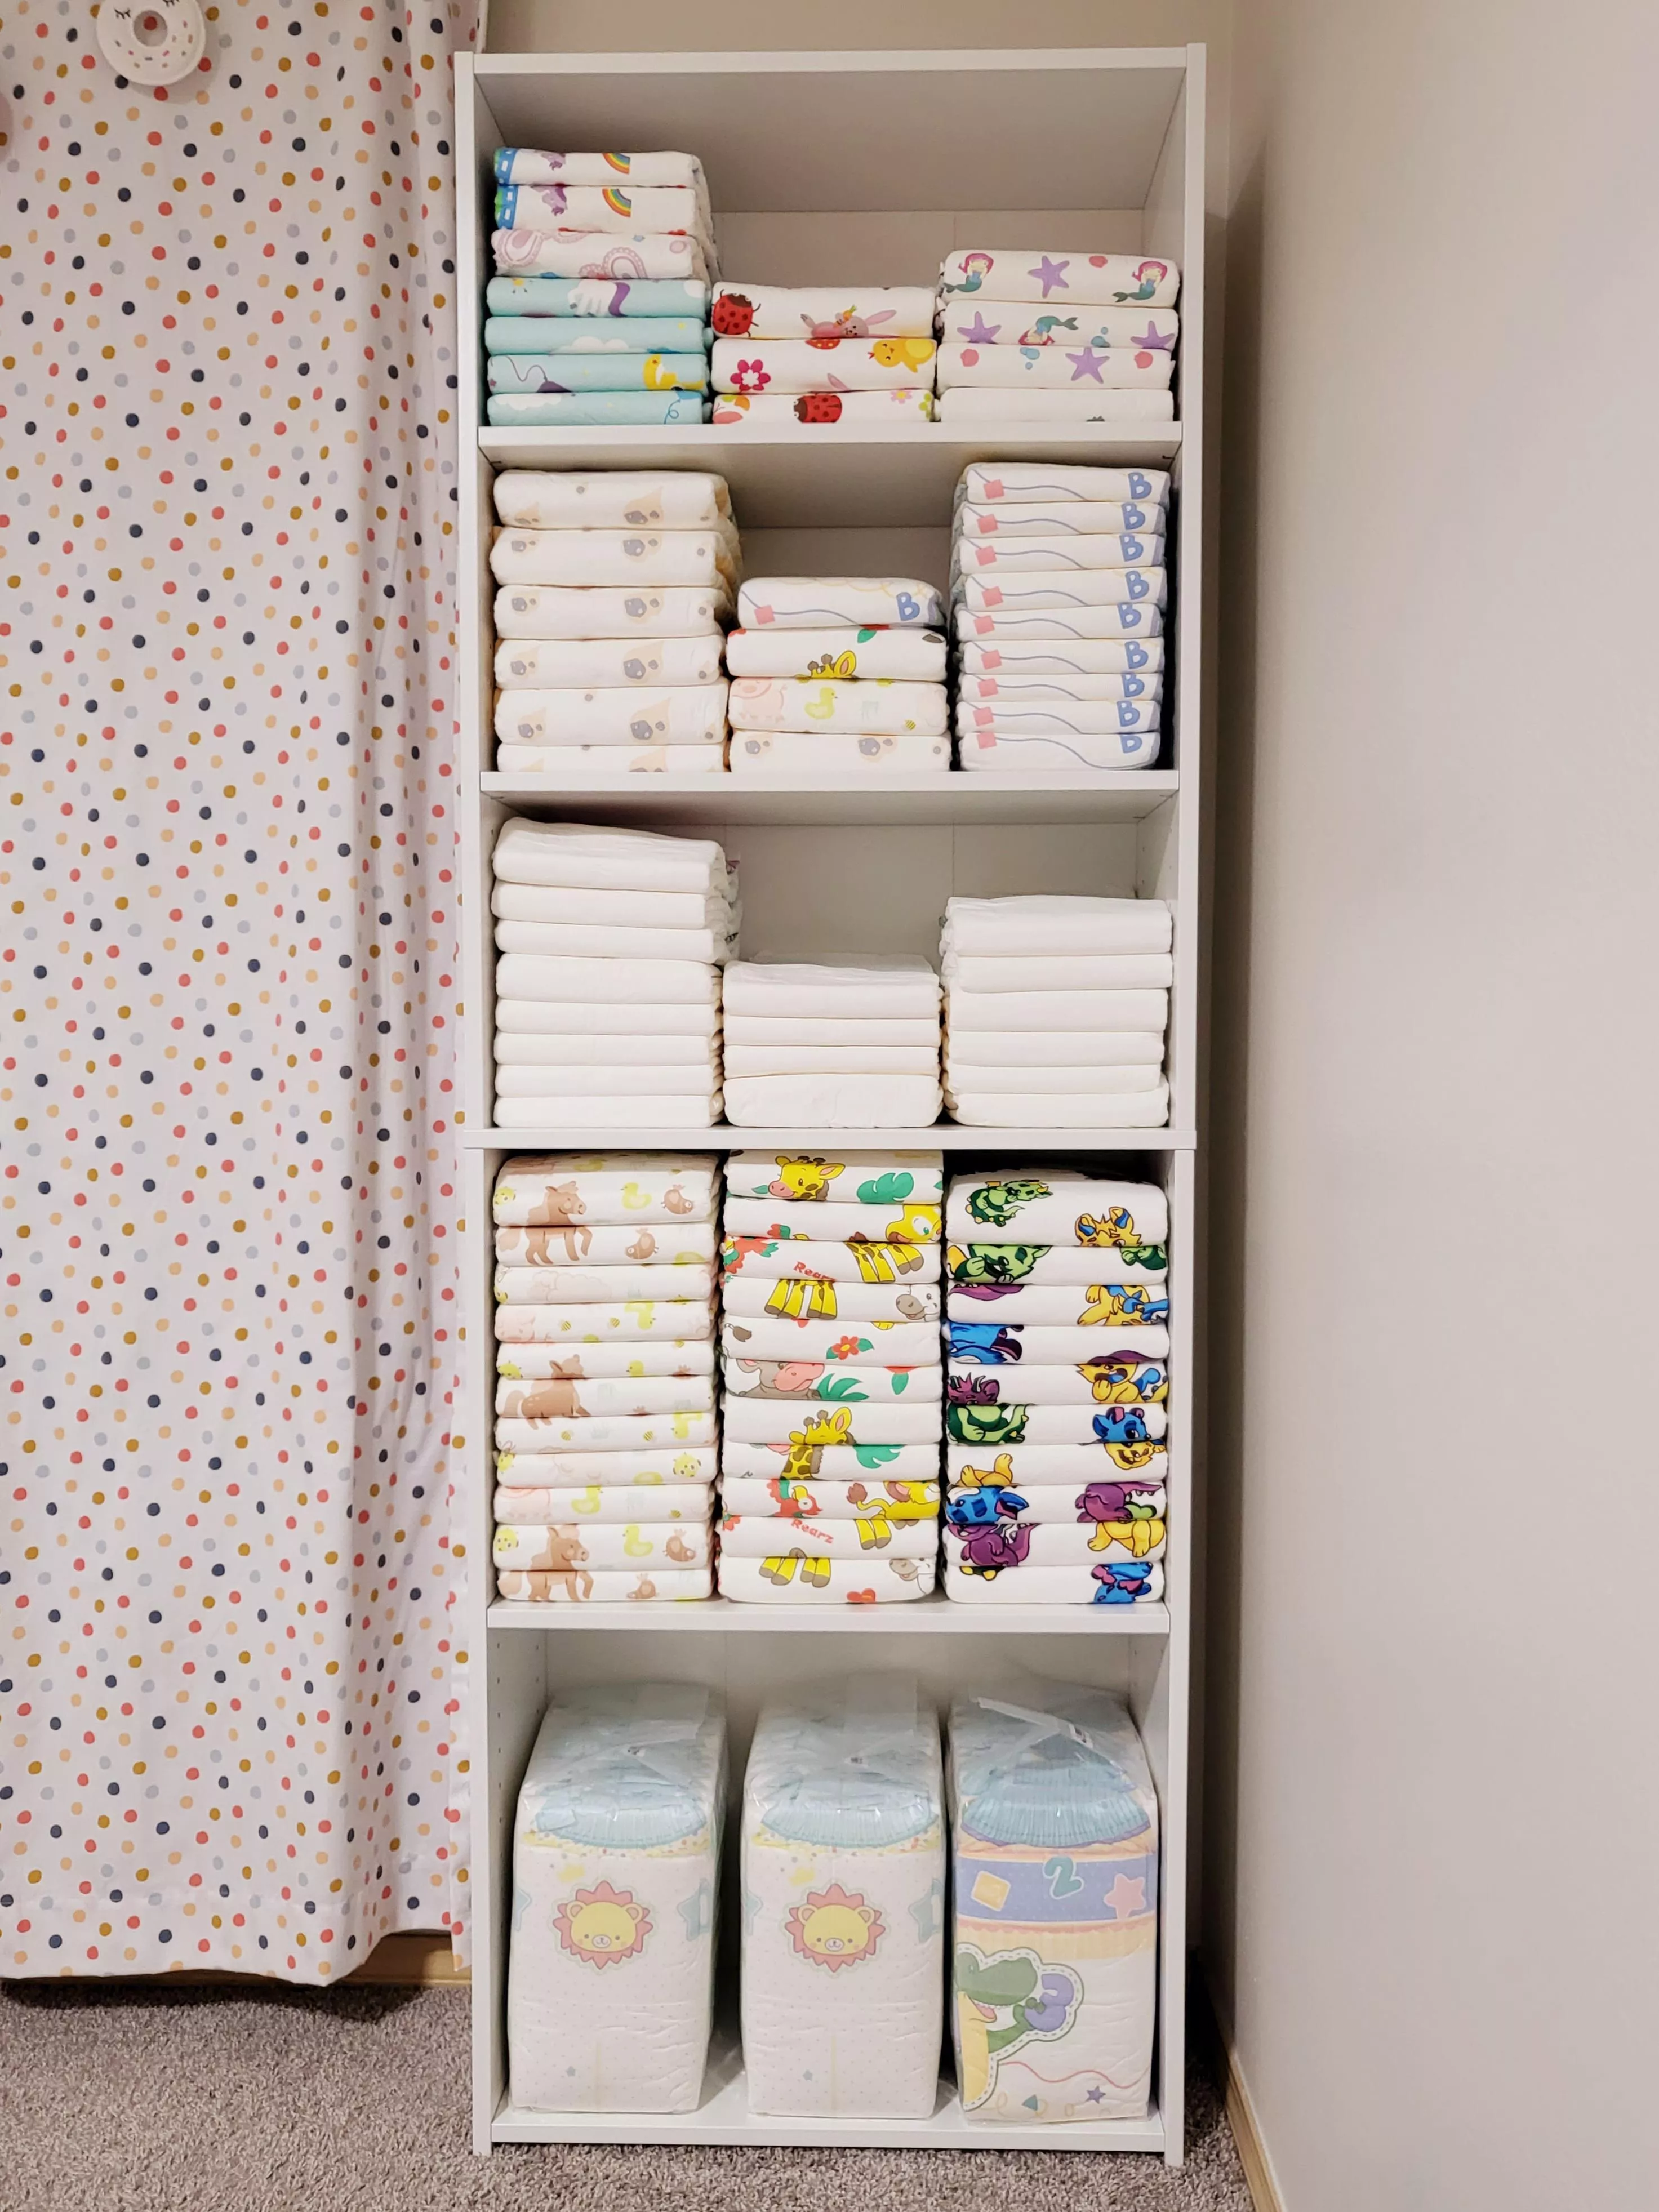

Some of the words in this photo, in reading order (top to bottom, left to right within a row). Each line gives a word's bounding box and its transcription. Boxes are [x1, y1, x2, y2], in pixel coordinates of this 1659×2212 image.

[1128, 472, 1153, 500] B
[1121, 502, 1146, 530] B
[1119, 533, 1144, 562] B
[1125, 571, 1150, 600] B
[896, 592, 920, 621] B
[1117, 603, 1141, 629] B
[1124, 641, 1149, 669] B
[1122, 672, 1145, 697] B
[1117, 701, 1141, 727] B
[791, 1519, 834, 1544] Rearz
[1043, 1856, 1084, 1900] 2
